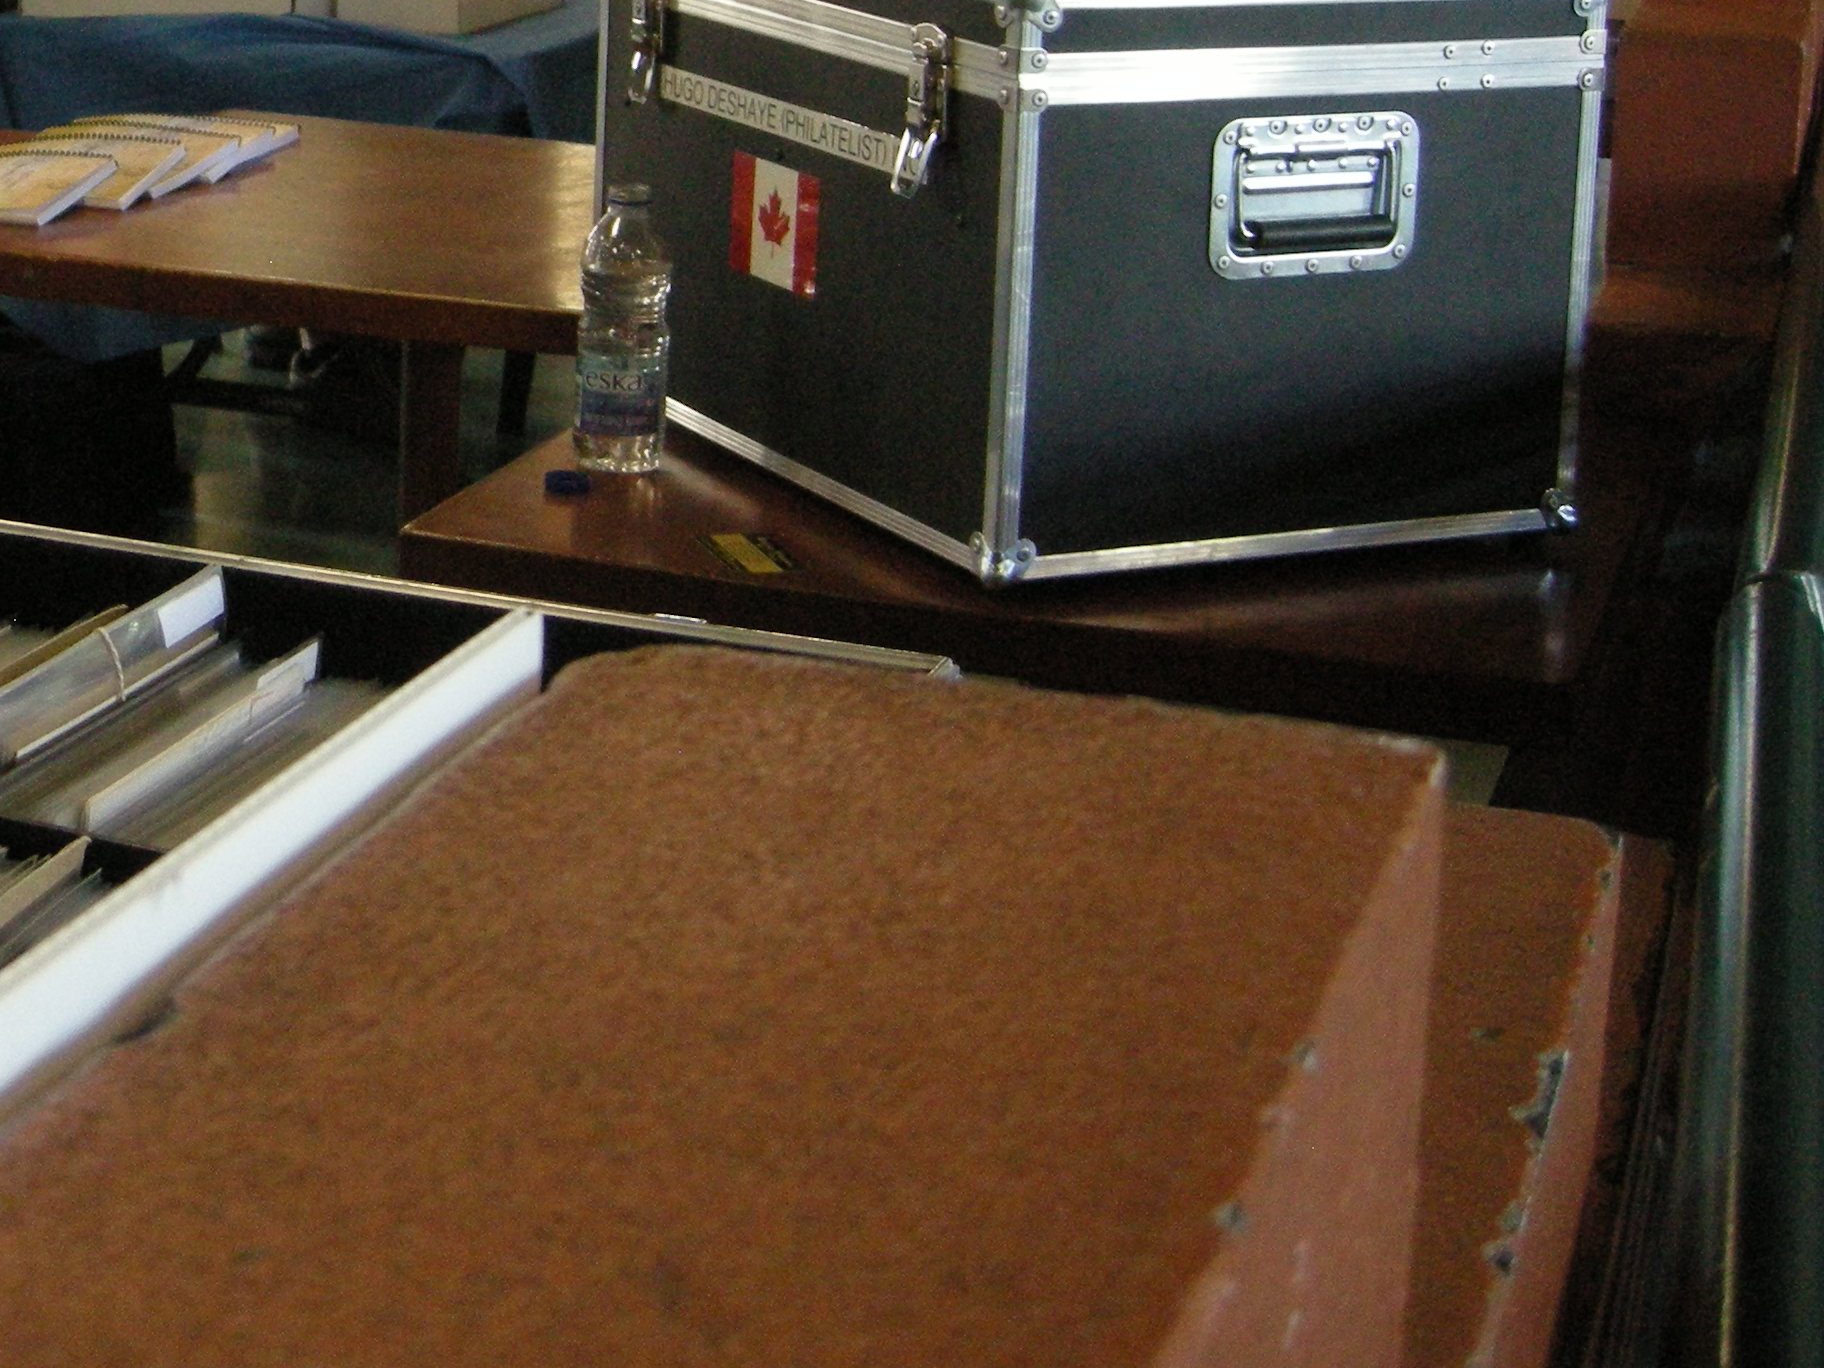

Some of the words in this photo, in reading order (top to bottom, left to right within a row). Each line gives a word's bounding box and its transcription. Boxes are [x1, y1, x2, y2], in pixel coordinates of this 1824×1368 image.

[661, 70, 704, 106] HUGO
[707, 84, 776, 130] DESHAYE
[781, 109, 886, 167] (PHILATELIST)
[585, 371, 643, 391] eska
